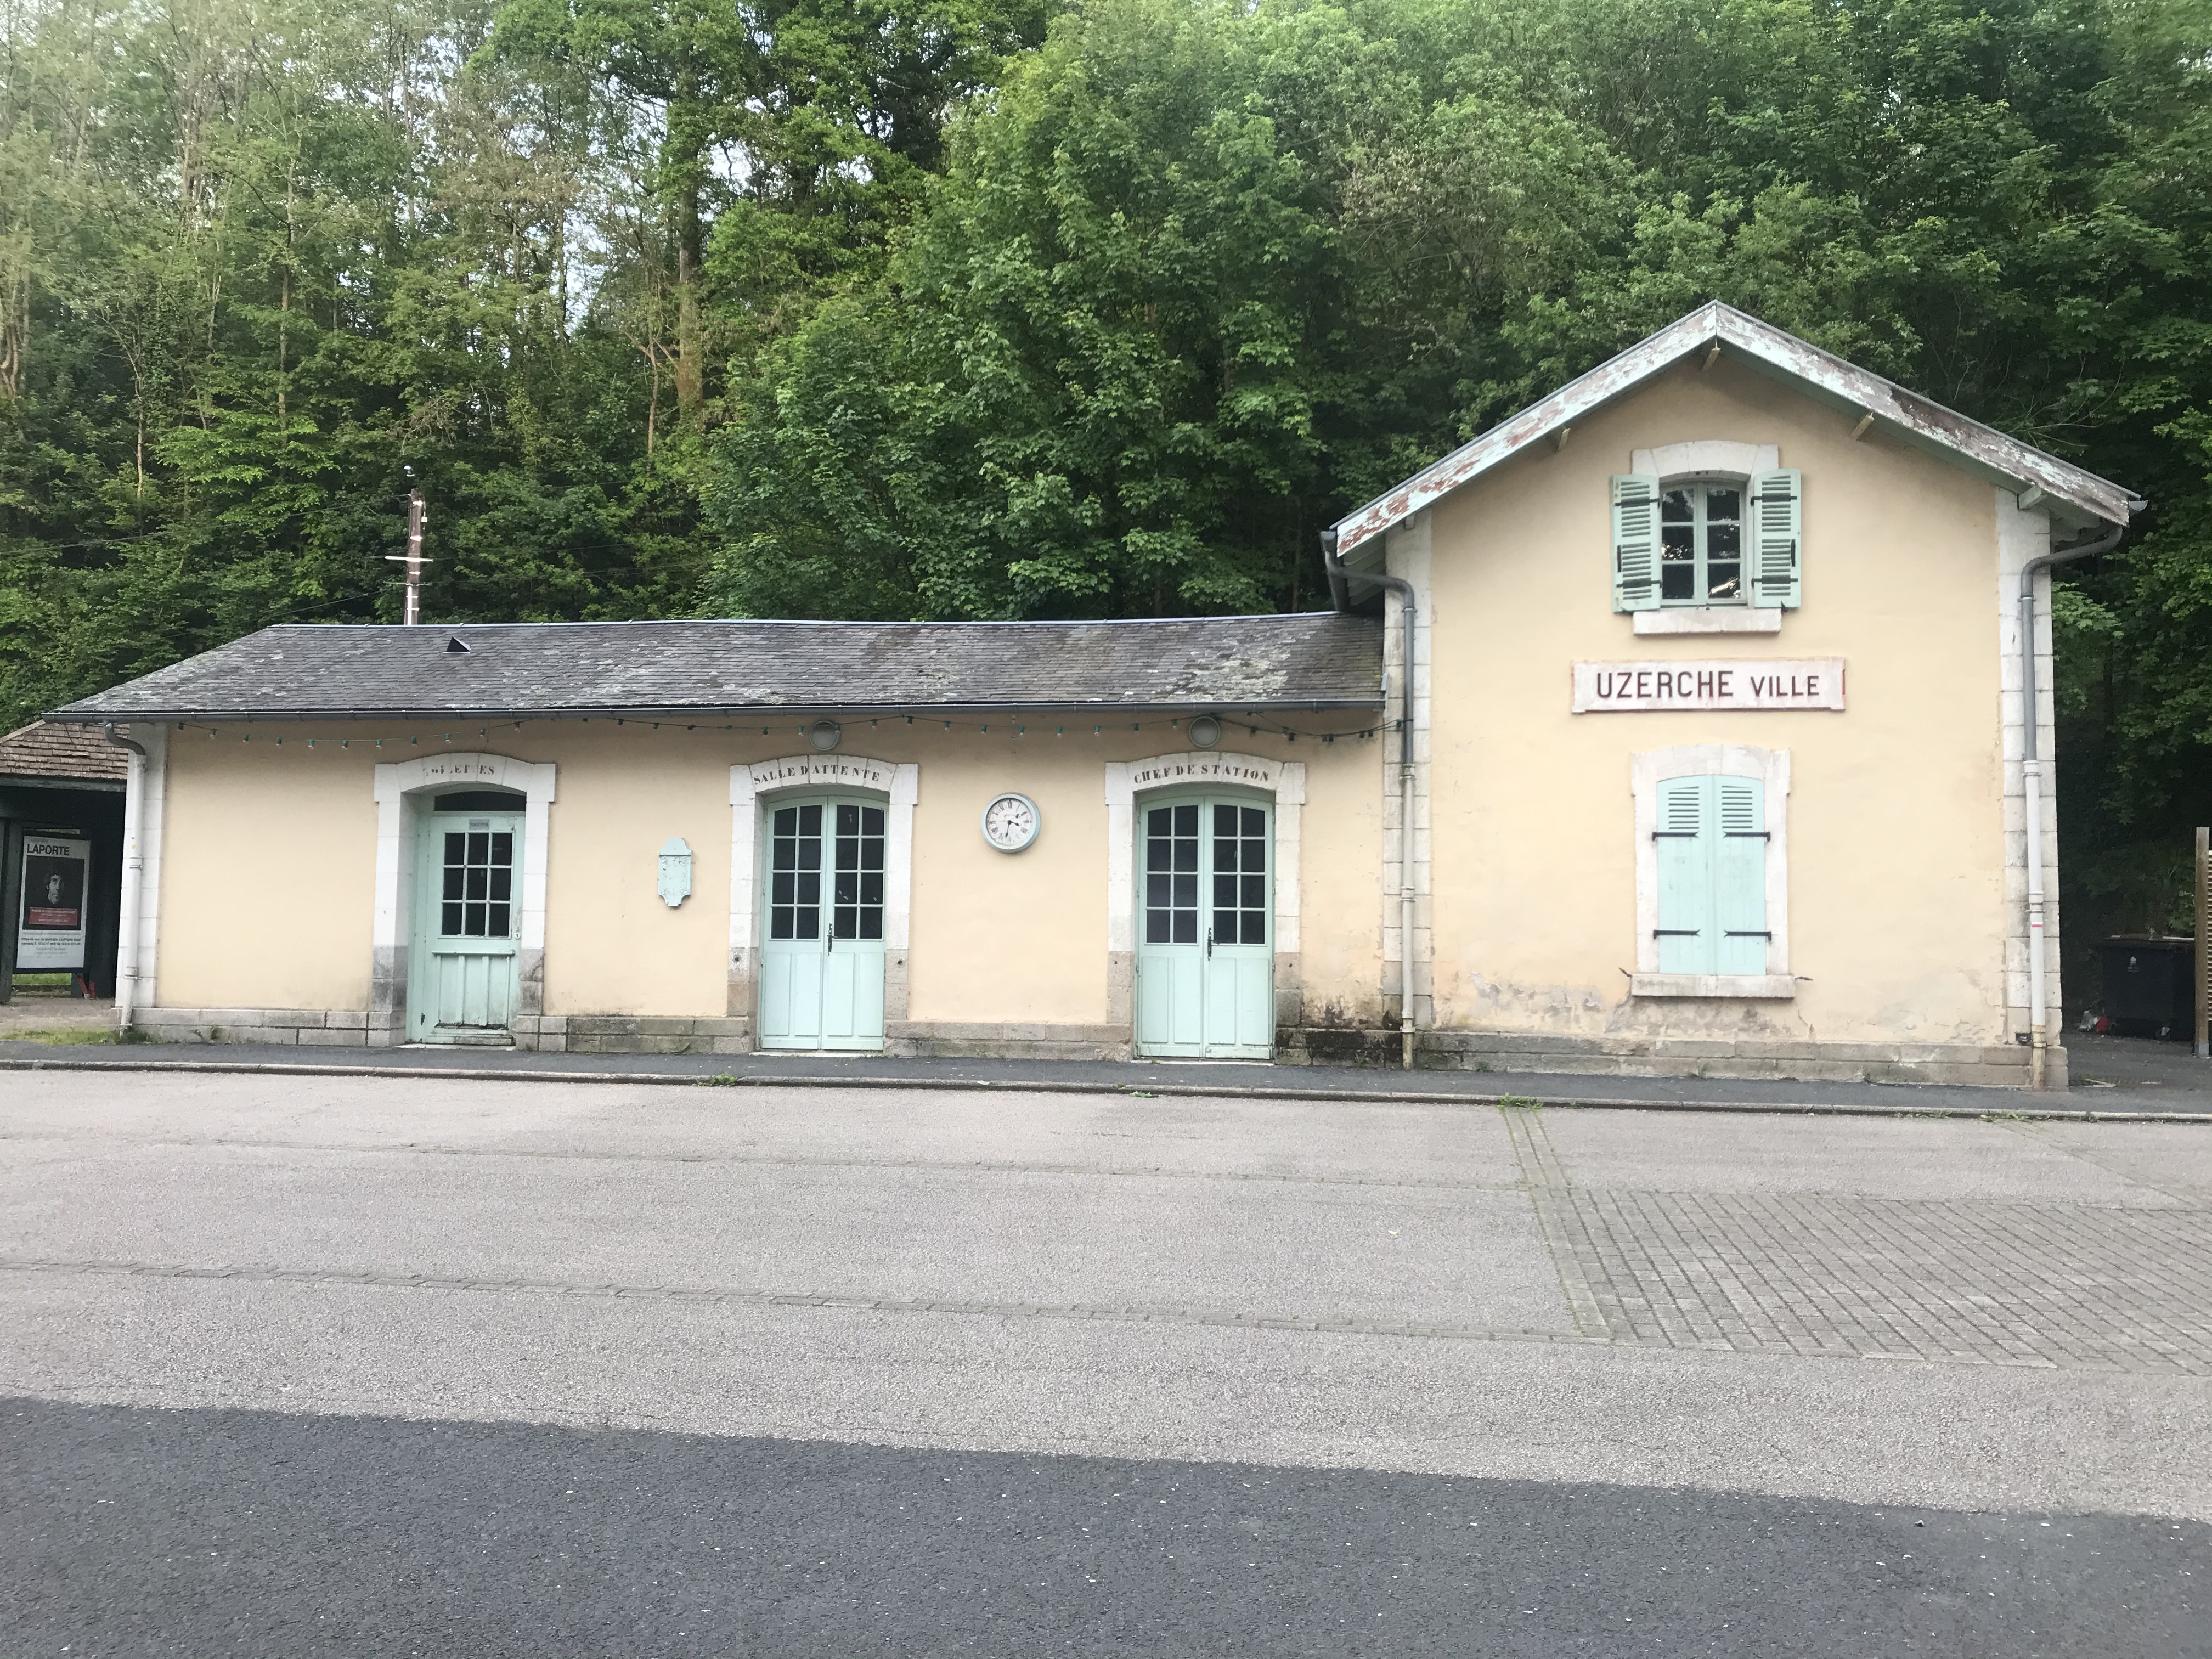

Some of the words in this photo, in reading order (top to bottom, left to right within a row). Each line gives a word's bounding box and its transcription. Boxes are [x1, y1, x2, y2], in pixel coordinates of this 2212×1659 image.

[1596, 670, 1734, 698] UZERCHE
[1751, 675, 1820, 697] VILLE
[753, 767, 795, 785] SALLE
[1134, 766, 1171, 783] CHEF
[1176, 764, 1195, 776] DE
[1201, 764, 1269, 782] STATION
[27, 844, 71, 856] LAPORTE
